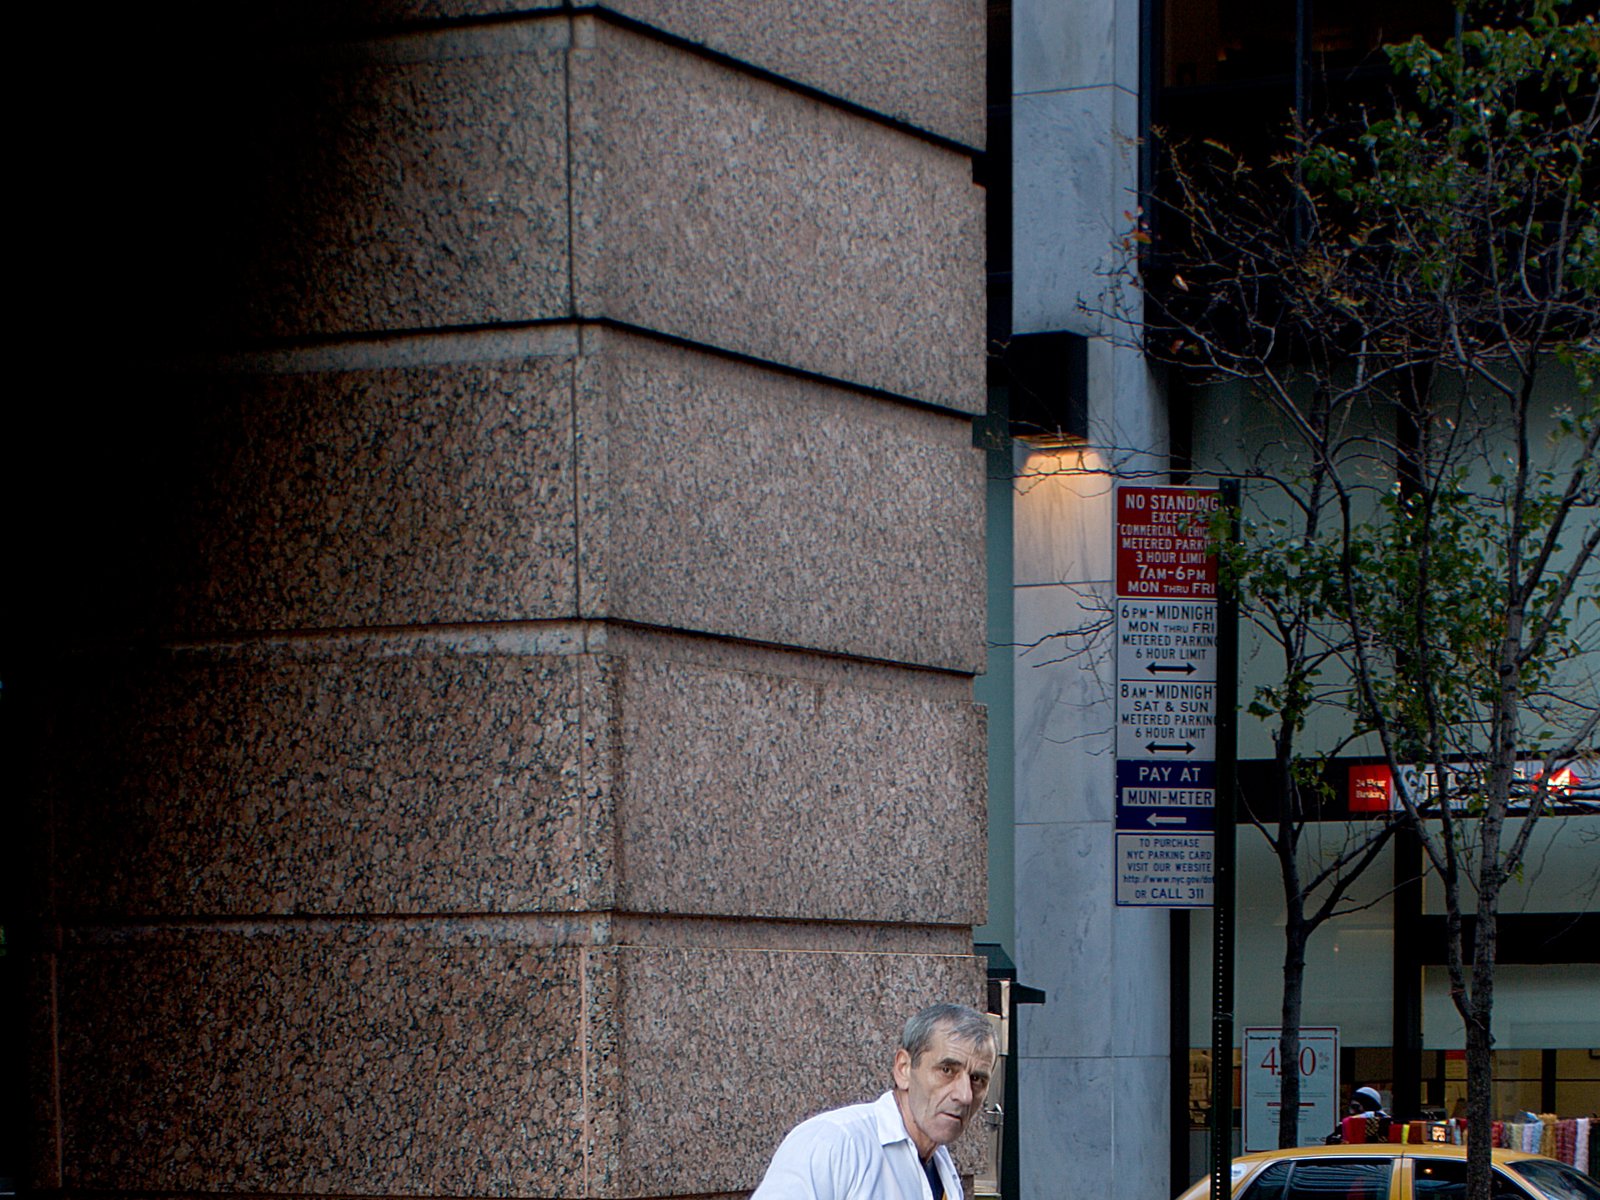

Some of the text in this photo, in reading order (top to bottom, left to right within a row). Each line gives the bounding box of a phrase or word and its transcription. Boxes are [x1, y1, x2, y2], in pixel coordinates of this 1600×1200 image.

[1125, 494, 1145, 509] NO
[1120, 524, 1178, 537] COMMERCIAL
[1122, 537, 1172, 550] METERED
[1136, 551, 1143, 563] 3
[1146, 552, 1176, 563] HOUR
[1137, 564, 1206, 580] 7AM-6PM
[1127, 581, 1215, 594] MON THRU FRI
[1128, 621, 1215, 633] MON THRU FRI
[1122, 634, 1171, 646] METERED
[1136, 648, 1207, 660] 6 HOUR LIMIT
[1133, 700, 1209, 713] SAT & SUN
[1122, 714, 1216, 726] METERED PARKIN
[1135, 727, 1206, 739] 6 HOUR LIMIT
[1139, 767, 1201, 782] PAY AT
[1128, 790, 1212, 805] MUNI-METER
[1139, 838, 1200, 848] TO PURCHASE
[1127, 850, 1212, 860] NYC PARKING CARD
[1127, 862, 1212, 873] VISIT OUR WEBSITE
[1135, 888, 1204, 899] OR CALL 311
